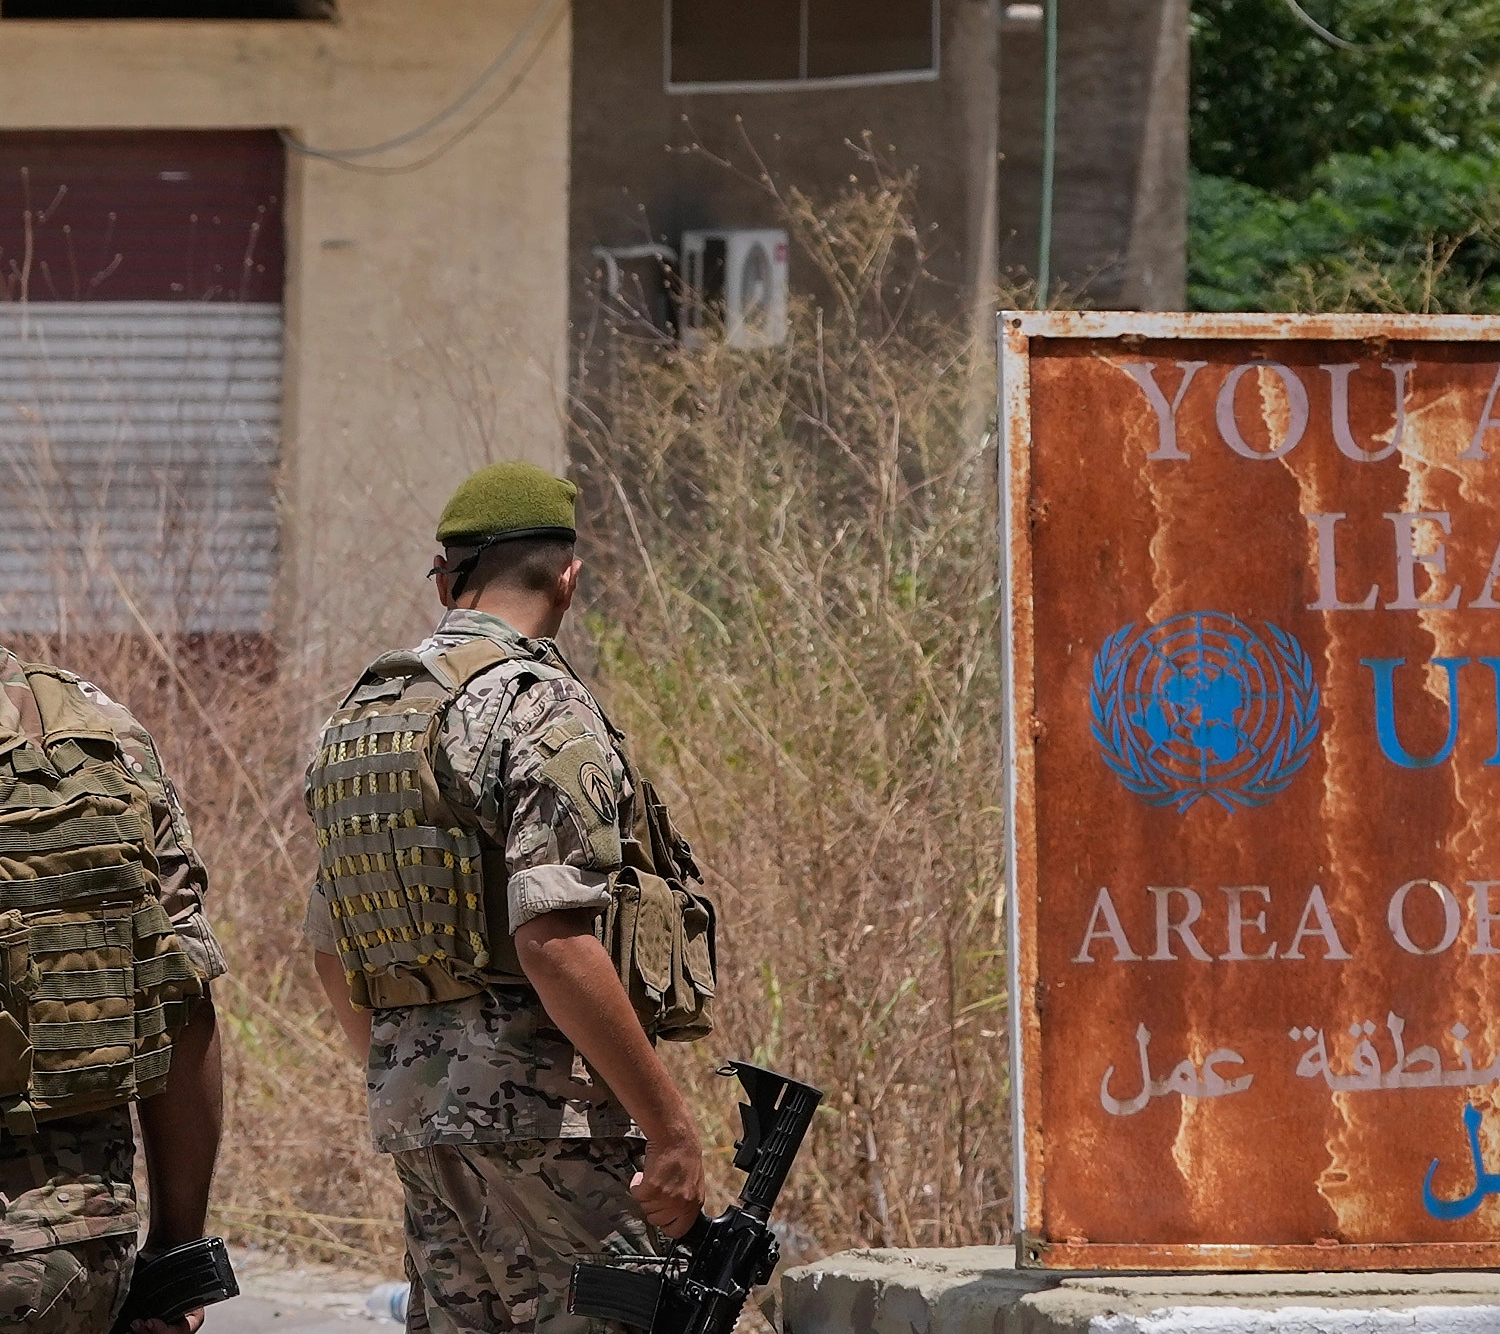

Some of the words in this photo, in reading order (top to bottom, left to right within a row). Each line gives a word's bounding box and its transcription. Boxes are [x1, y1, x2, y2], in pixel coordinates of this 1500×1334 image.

[1120, 359, 1418, 462] YOU
[1070, 883, 1353, 962] AREA
[1101, 1021, 1255, 1116] عمل
